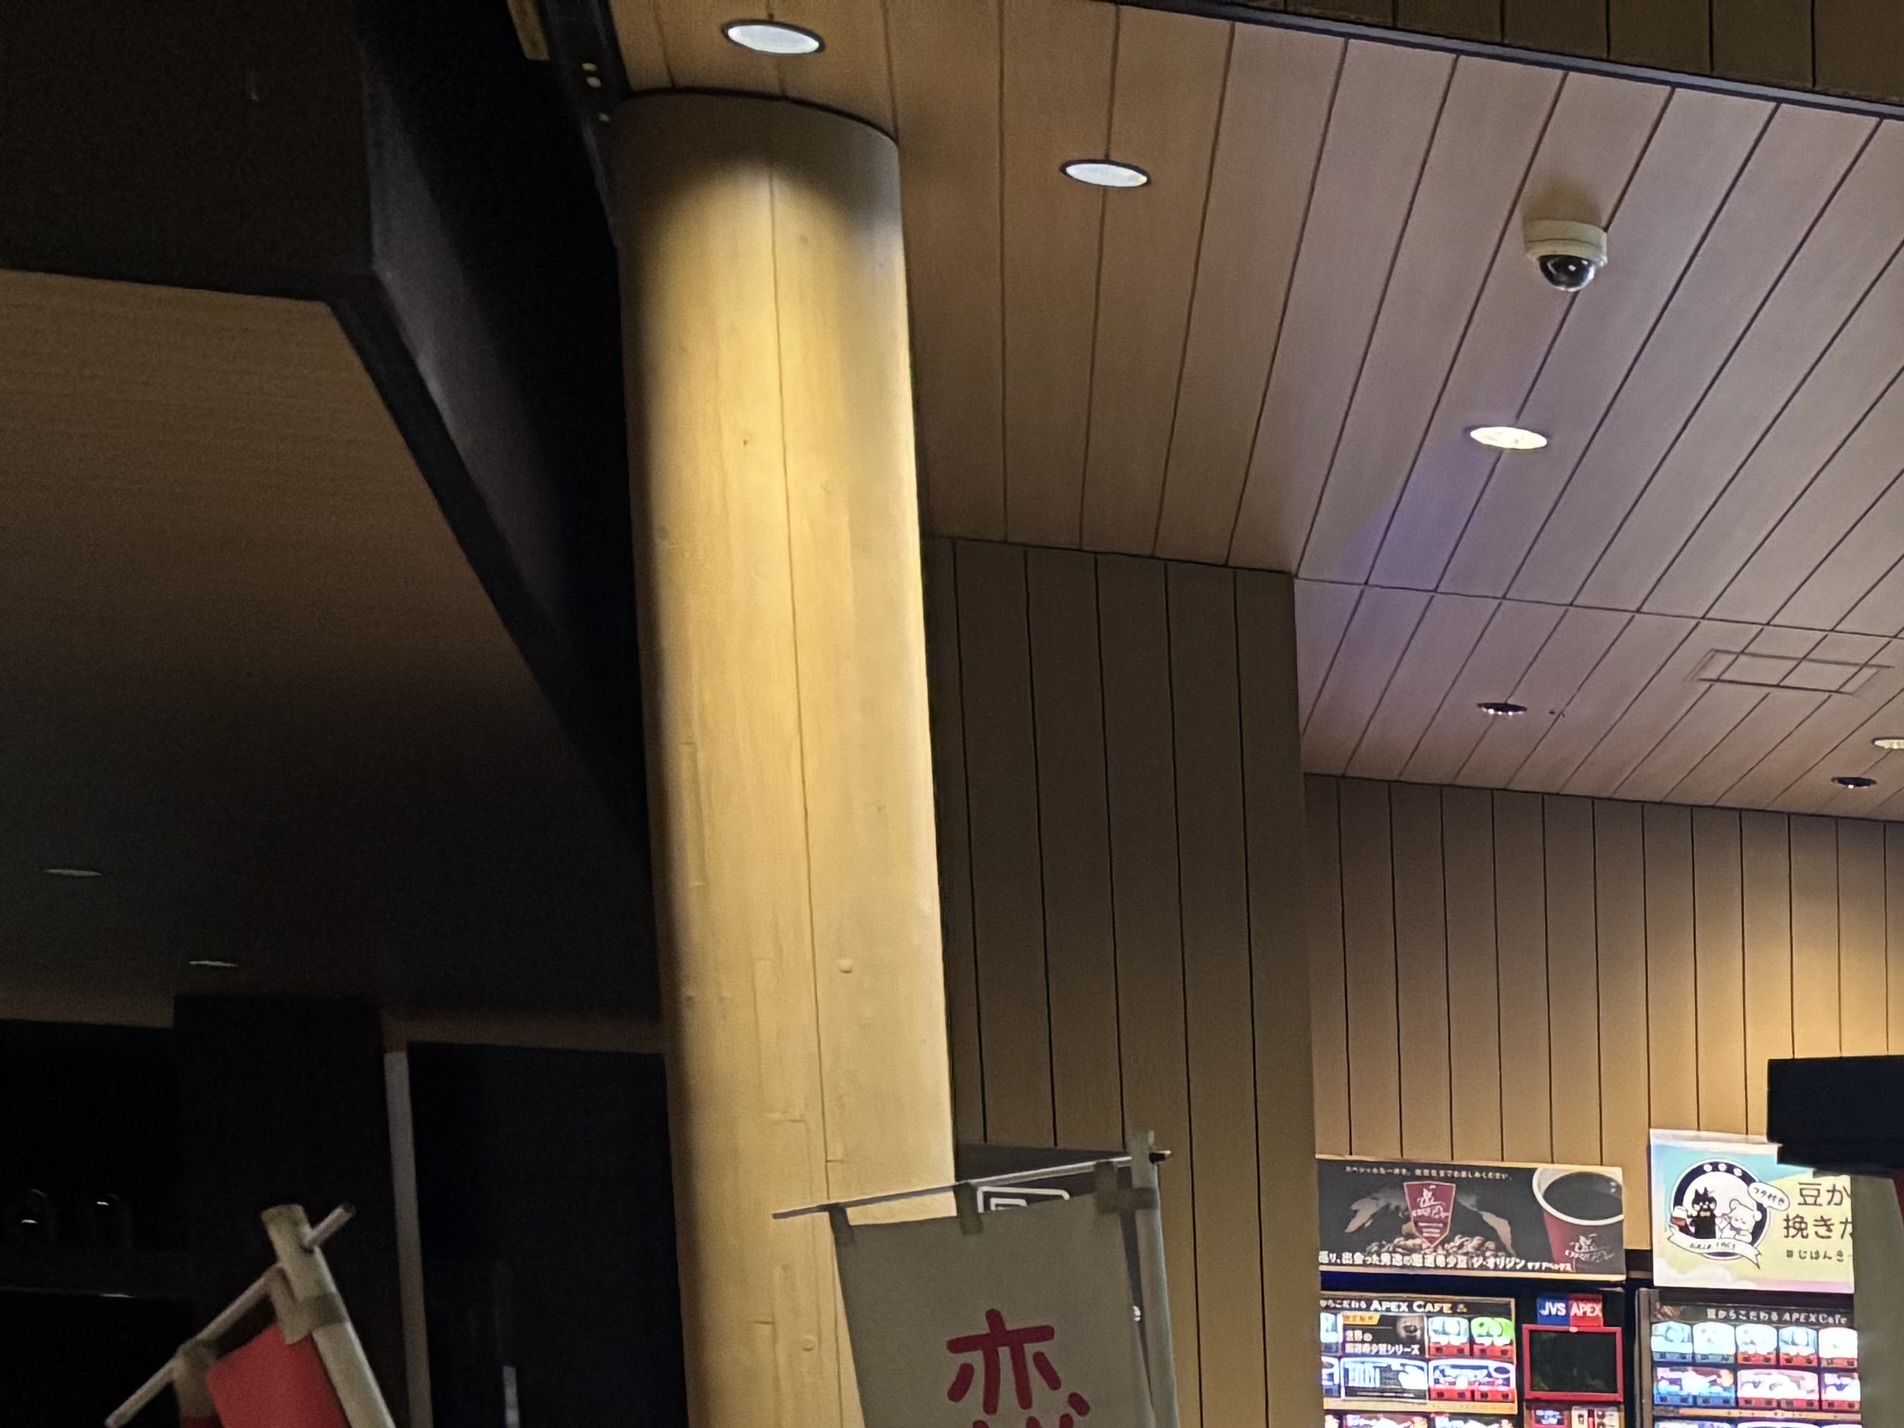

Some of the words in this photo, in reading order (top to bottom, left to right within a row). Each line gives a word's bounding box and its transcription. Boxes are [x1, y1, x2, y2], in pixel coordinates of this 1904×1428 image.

[1786, 1249, 1853, 1262] #じはんき
[1370, 1299, 1409, 1312] APEX
[1412, 1301, 1453, 1313] CAFE
[1538, 1301, 1567, 1317] JVS
[1571, 1302, 1602, 1319] APEX
